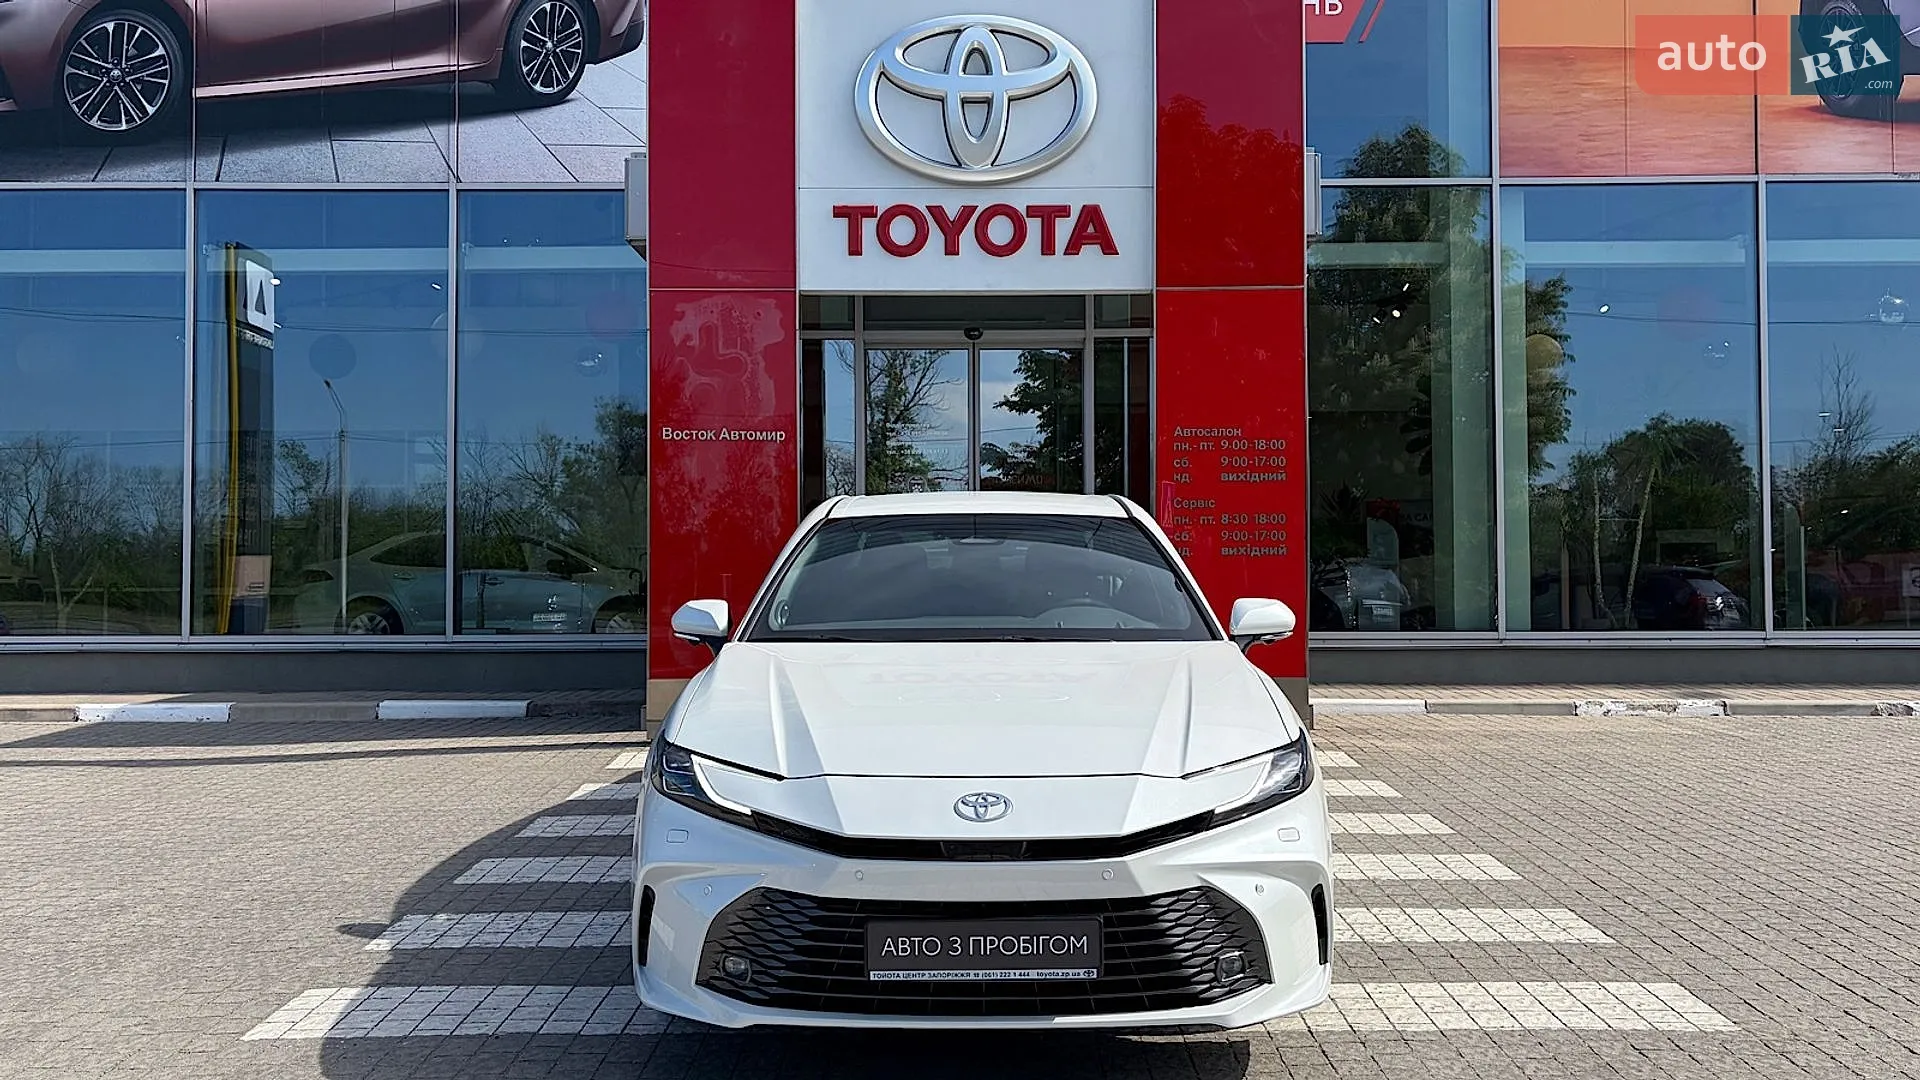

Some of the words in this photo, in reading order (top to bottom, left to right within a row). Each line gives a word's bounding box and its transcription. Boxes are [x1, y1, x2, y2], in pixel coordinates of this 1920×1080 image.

[832, 203, 1120, 258] TOYOTA
[662, 427, 716, 440] Восток
[719, 427, 786, 443] Автомир
[1174, 426, 1242, 437] Автосалон
[1173, 457, 1193, 468] сб.
[1173, 473, 1193, 483] нд.
[1221, 470, 1287, 483] вихідний
[1173, 497, 1216, 509] Сервіс
[1221, 530, 1287, 541] 9:00-17:00
[1221, 544, 1288, 557] вихідний
[881, 936, 941, 956] АВТО
[969, 935, 1087, 956] ПРОБІГОМ
[903, 971, 926, 980] ЦЕНТР
